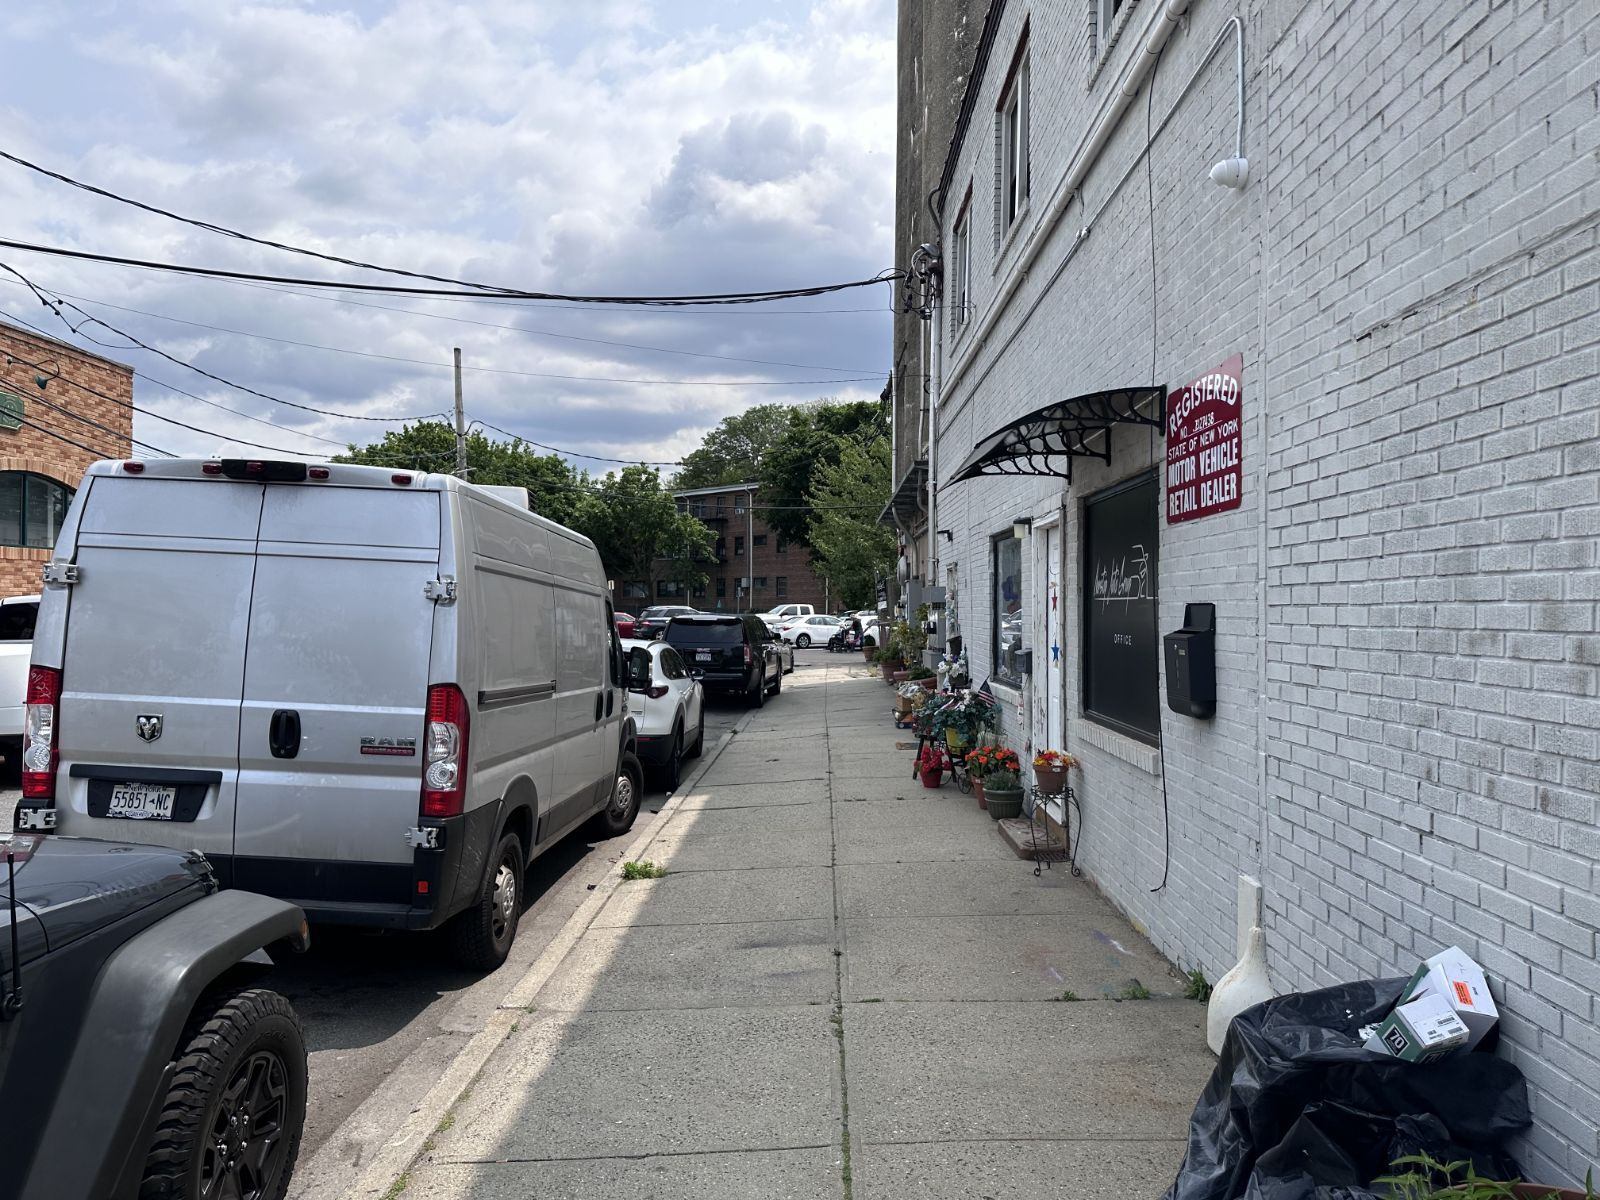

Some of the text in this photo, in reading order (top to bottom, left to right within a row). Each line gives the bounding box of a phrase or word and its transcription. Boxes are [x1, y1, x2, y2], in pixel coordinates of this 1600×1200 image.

[1169, 374, 1238, 437] REGISTERED
[1168, 418, 1239, 461] STATE OF NEW YORK
[1168, 437, 1238, 488] MOTOR VEHICLE
[1169, 472, 1237, 517] RETAIL DEALER
[1113, 633, 1132, 646] OFFICE
[360, 736, 416, 746] RAM
[1389, 1029, 1405, 1049] 70
